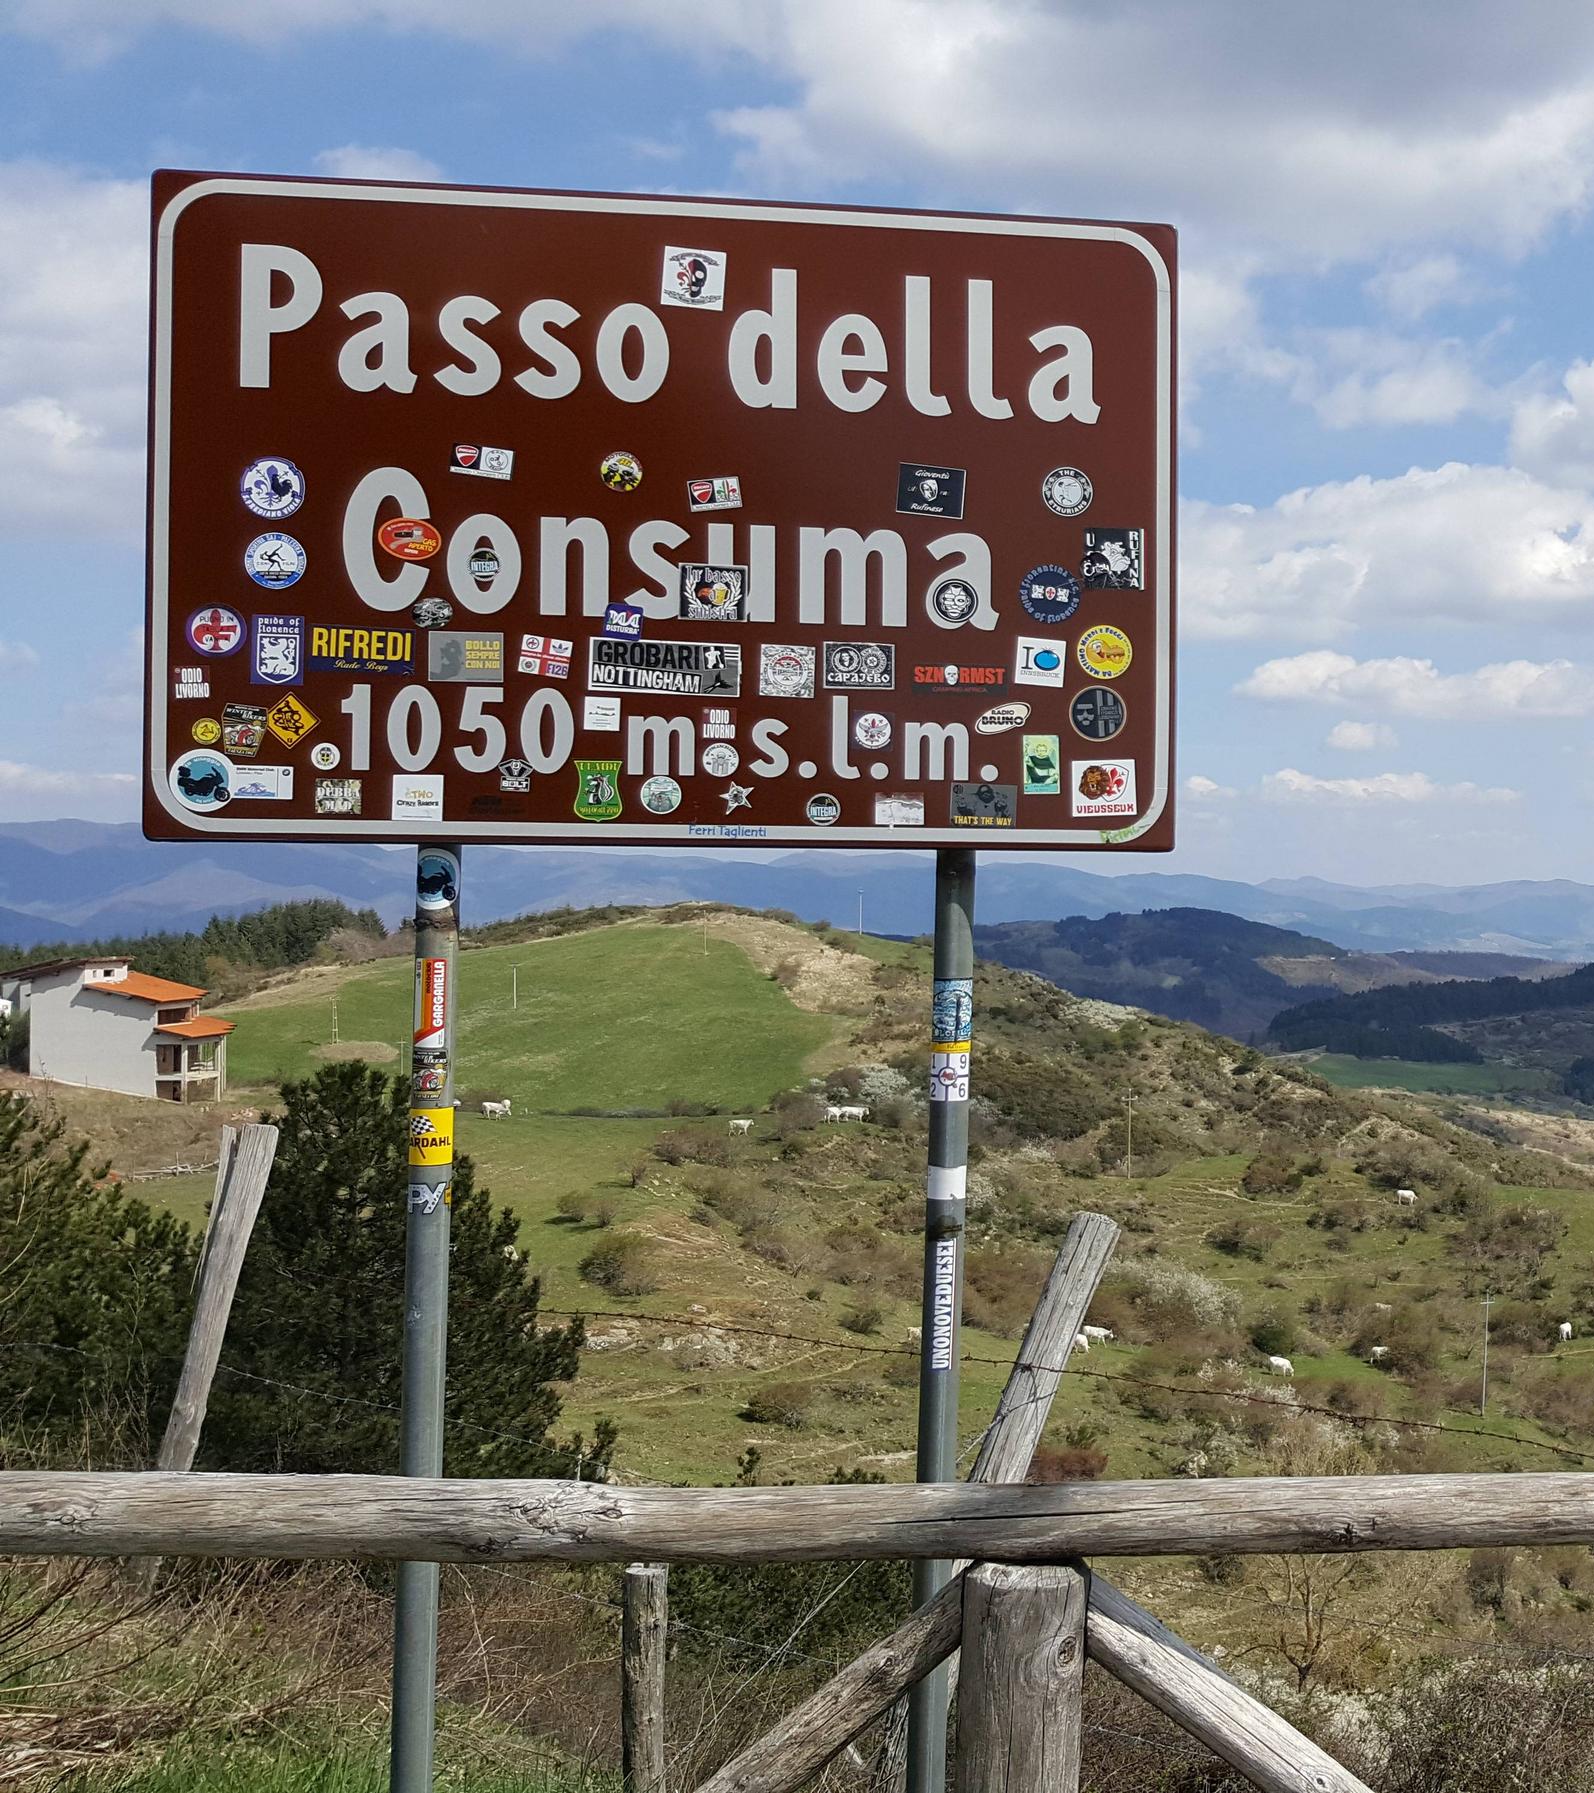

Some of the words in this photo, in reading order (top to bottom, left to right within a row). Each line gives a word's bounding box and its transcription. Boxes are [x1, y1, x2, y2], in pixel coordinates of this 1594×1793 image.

[240, 243, 670, 403] Passo
[727, 268, 1102, 425] della
[911, 502, 944, 513] Rufinese
[1048, 499, 1087, 514] ETRURIANS
[342, 466, 1000, 631] Consuma
[1128, 530, 1140, 588] RUFINA
[704, 567, 742, 583] basso
[687, 604, 738, 620] sinistra
[312, 627, 412, 661] RIFREDI
[465, 651, 500, 660] SEMPRE
[597, 641, 700, 670] GROBARI
[1021, 646, 1035, 670] I
[366, 661, 389, 673] Boys
[465, 660, 483, 669] CON
[485, 661, 500, 669] NOI
[181, 667, 202, 683] ODIO
[592, 664, 700, 693] NOTTINGHAM
[175, 682, 210, 699] LIVORNO
[709, 709, 730, 724] ODIO
[981, 716, 1024, 726] BRUNO
[341, 684, 575, 774] 1050
[703, 723, 736, 739] LIVORNO
[811, 805, 837, 817] INTEGRA
[1076, 804, 1135, 815] VIEUSSEUX
[953, 815, 979, 826] THAT'S
[980, 816, 994, 825] THE
[996, 817, 1012, 827] WAY
[688, 824, 717, 836] Ferri
[718, 825, 767, 839] Taglienti
[432, 961, 445, 1028] GARGANELLA
[931, 1053, 937, 1069] 1
[960, 1055, 967, 1069] 9
[930, 1082, 937, 1098] 2
[959, 1083, 966, 1098] 6
[931, 1240, 954, 1370] UNONOVEDUESEI
